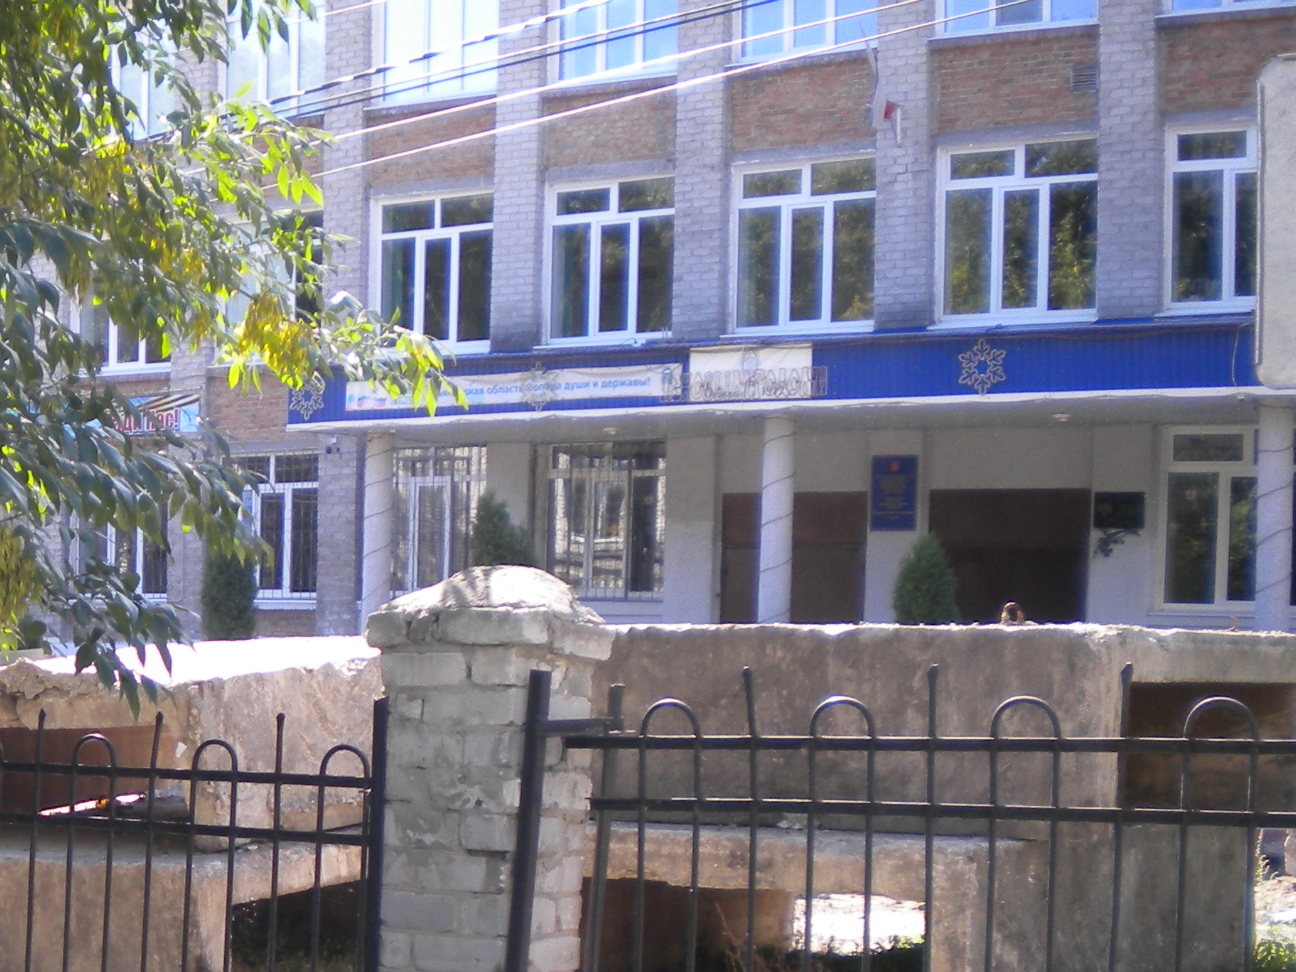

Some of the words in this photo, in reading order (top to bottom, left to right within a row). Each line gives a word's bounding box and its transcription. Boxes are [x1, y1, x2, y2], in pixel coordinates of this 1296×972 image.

[563, 379, 590, 391] души
[592, 380, 599, 388] и
[601, 376, 651, 389] державы!
